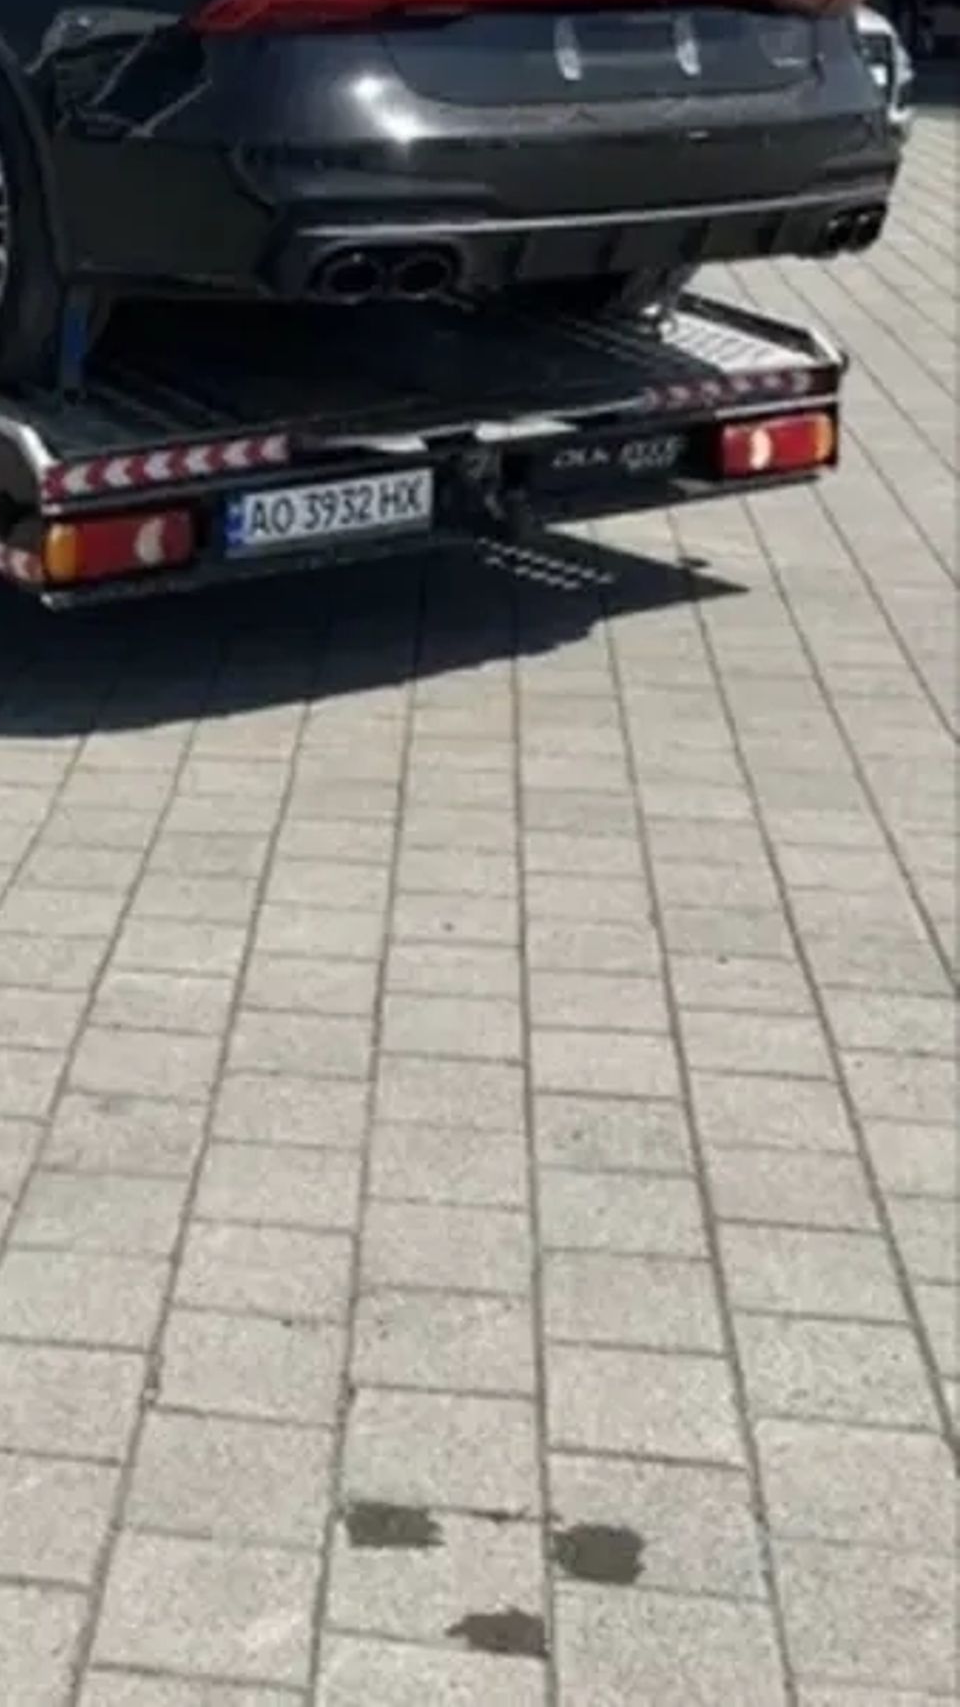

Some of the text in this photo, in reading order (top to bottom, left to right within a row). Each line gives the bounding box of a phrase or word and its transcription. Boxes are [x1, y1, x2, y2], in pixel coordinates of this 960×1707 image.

[250, 476, 424, 536] AO 3932 HX
